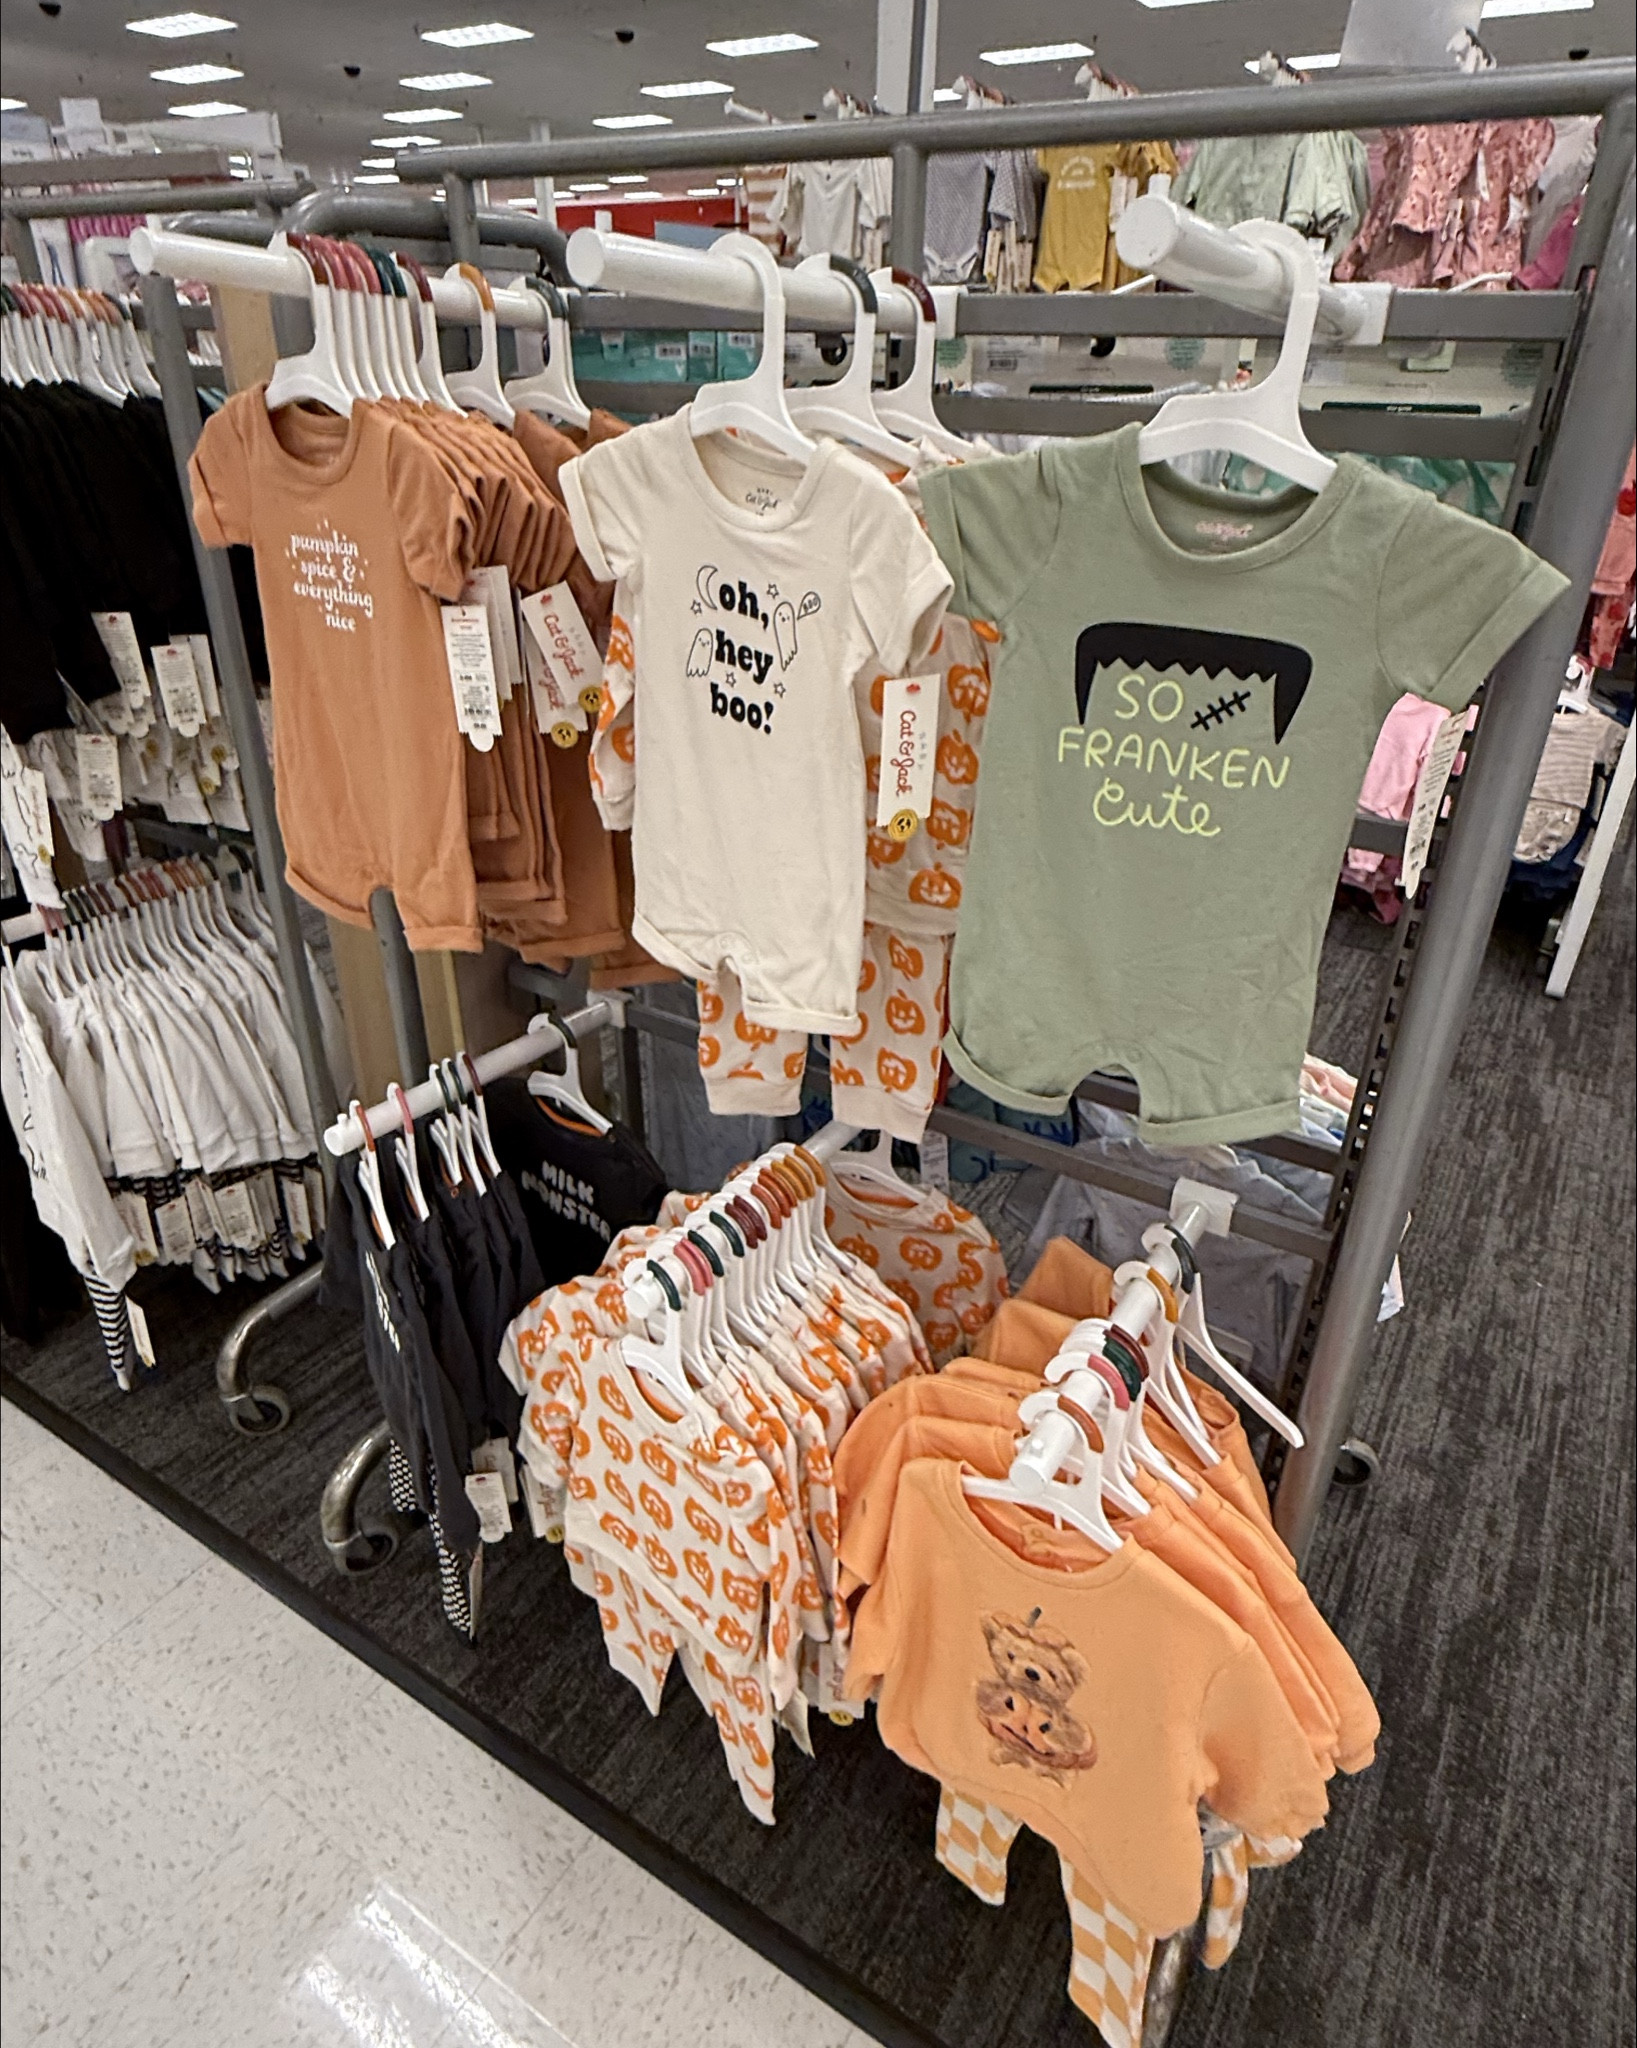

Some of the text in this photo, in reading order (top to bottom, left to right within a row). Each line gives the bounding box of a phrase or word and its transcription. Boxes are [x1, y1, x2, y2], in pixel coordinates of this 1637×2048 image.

[290, 529, 359, 564] pumpkin
[301, 556, 356, 585] spice &
[293, 579, 374, 620] everything
[325, 607, 357, 634] nice
[718, 580, 770, 630] oh,
[544, 612, 563, 639] Cat
[552, 648, 585, 680] Jack
[715, 628, 773, 685] hey
[710, 682, 775, 735] boo!
[1114, 674, 1185, 723] SO
[890, 710, 917, 798] Cat & Jack
[1057, 726, 1291, 789] FRANKEN
[521, 1170, 612, 1243] MONSTER
[542, 1160, 595, 1207] MILK
